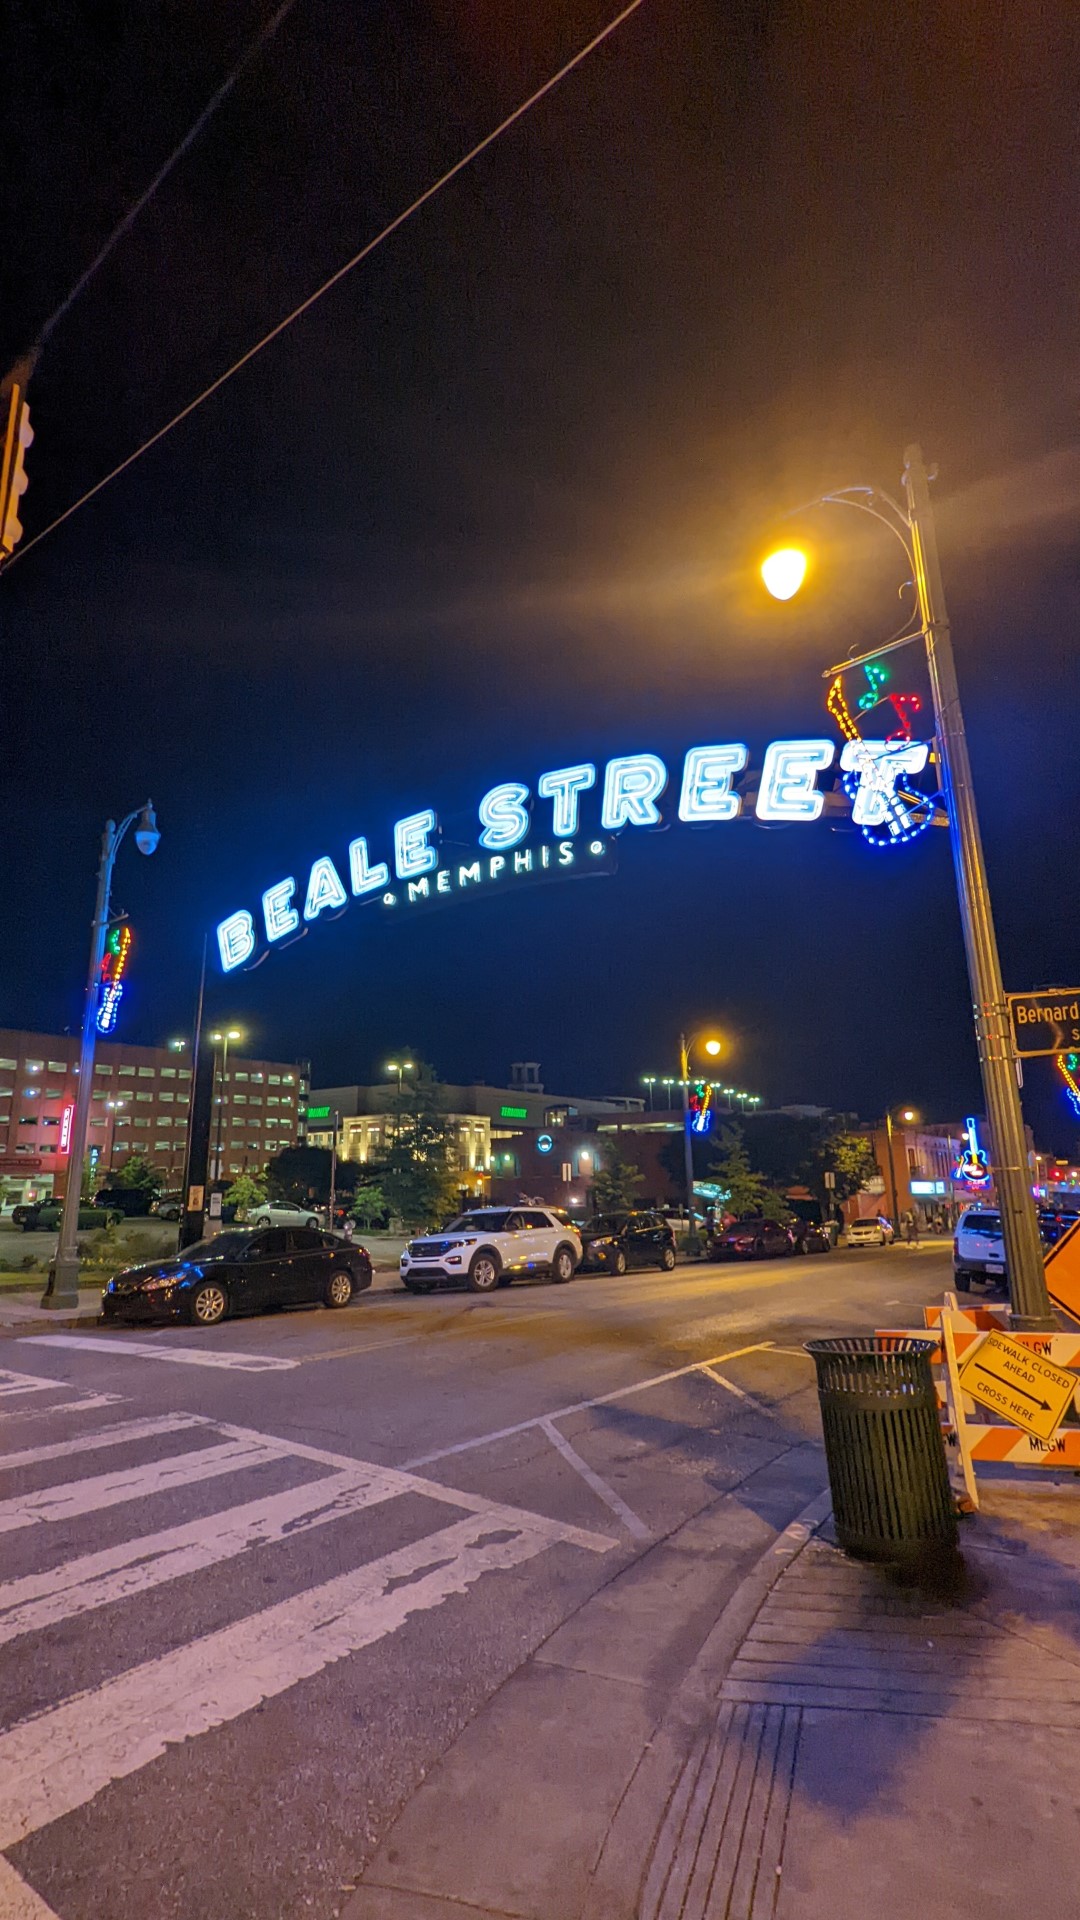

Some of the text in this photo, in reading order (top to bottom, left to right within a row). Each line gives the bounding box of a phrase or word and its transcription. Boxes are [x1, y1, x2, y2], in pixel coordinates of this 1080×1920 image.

[217, 738, 929, 973] BEALE STREET
[408, 842, 574, 902] MEMPHIS
[1017, 1001, 1079, 1024] Bernard
[987, 1337, 1070, 1389] SIDEWALK CLOSED
[1003, 1361, 1036, 1383] AHEAD
[976, 1382, 1035, 1422] CROSS HERE
